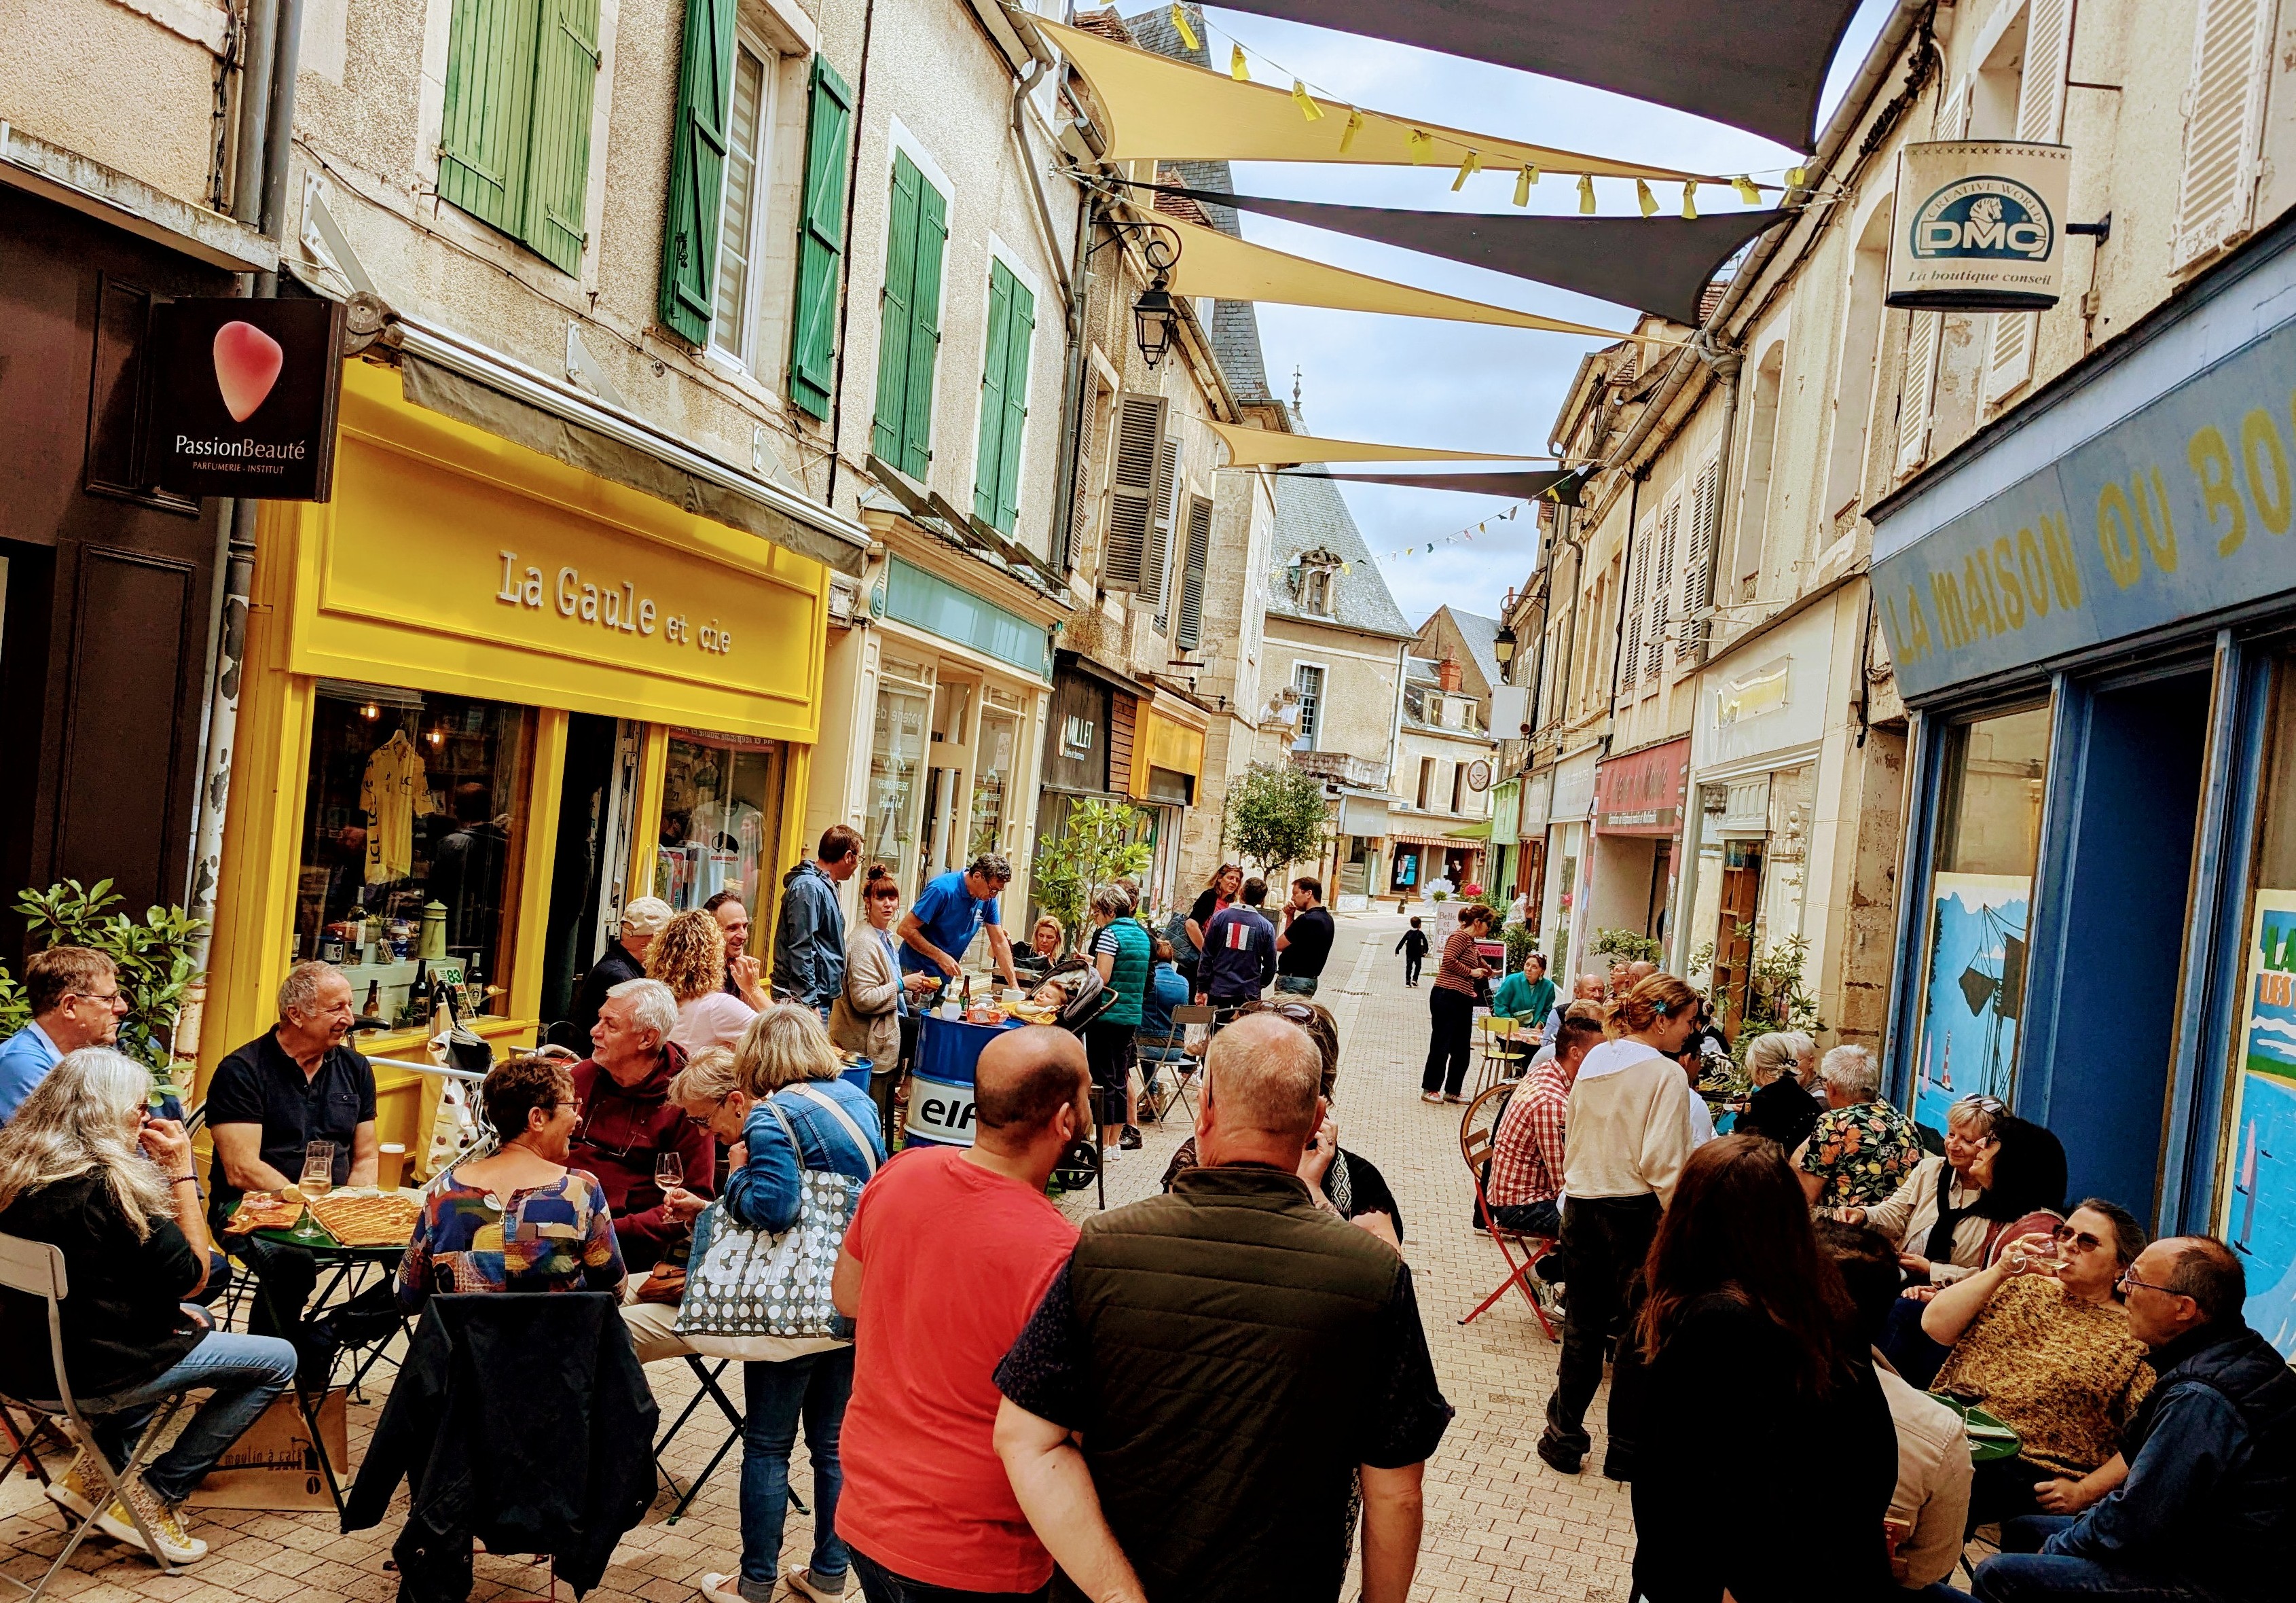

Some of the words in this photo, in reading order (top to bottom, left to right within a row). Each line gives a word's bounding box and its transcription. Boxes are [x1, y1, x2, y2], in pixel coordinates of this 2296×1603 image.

[1927, 182, 1995, 218] CREATIVE
[2001, 183, 2043, 222] WORLD
[1919, 220, 2047, 253] DMC
[1908, 271, 1927, 283] La
[1931, 270, 1999, 284] boutique
[2001, 274, 2052, 286] conseil
[175, 435, 306, 460] PassionBeauté
[192, 461, 242, 472] PARFUMERIE
[247, 465, 284, 474] INSTITUT
[1887, 583, 1931, 666] LA
[1929, 511, 2082, 650] MAISON
[2187, 387, 2296, 560] BO
[496, 550, 544, 607] La
[555, 566, 657, 634] Gaule
[665, 613, 689, 644] et
[697, 619, 731, 653] cie
[1066, 715, 1094, 749] MILLET
[1439, 912, 1456, 921] Belle
[1478, 947, 1501, 956] SERVICE
[446, 969, 462, 984] 83
[2260, 973, 2292, 1007] LES
[921, 1098, 977, 1130] elf
[704, 1230, 818, 1287] GiFi
[225, 1445, 262, 1465] moulin
